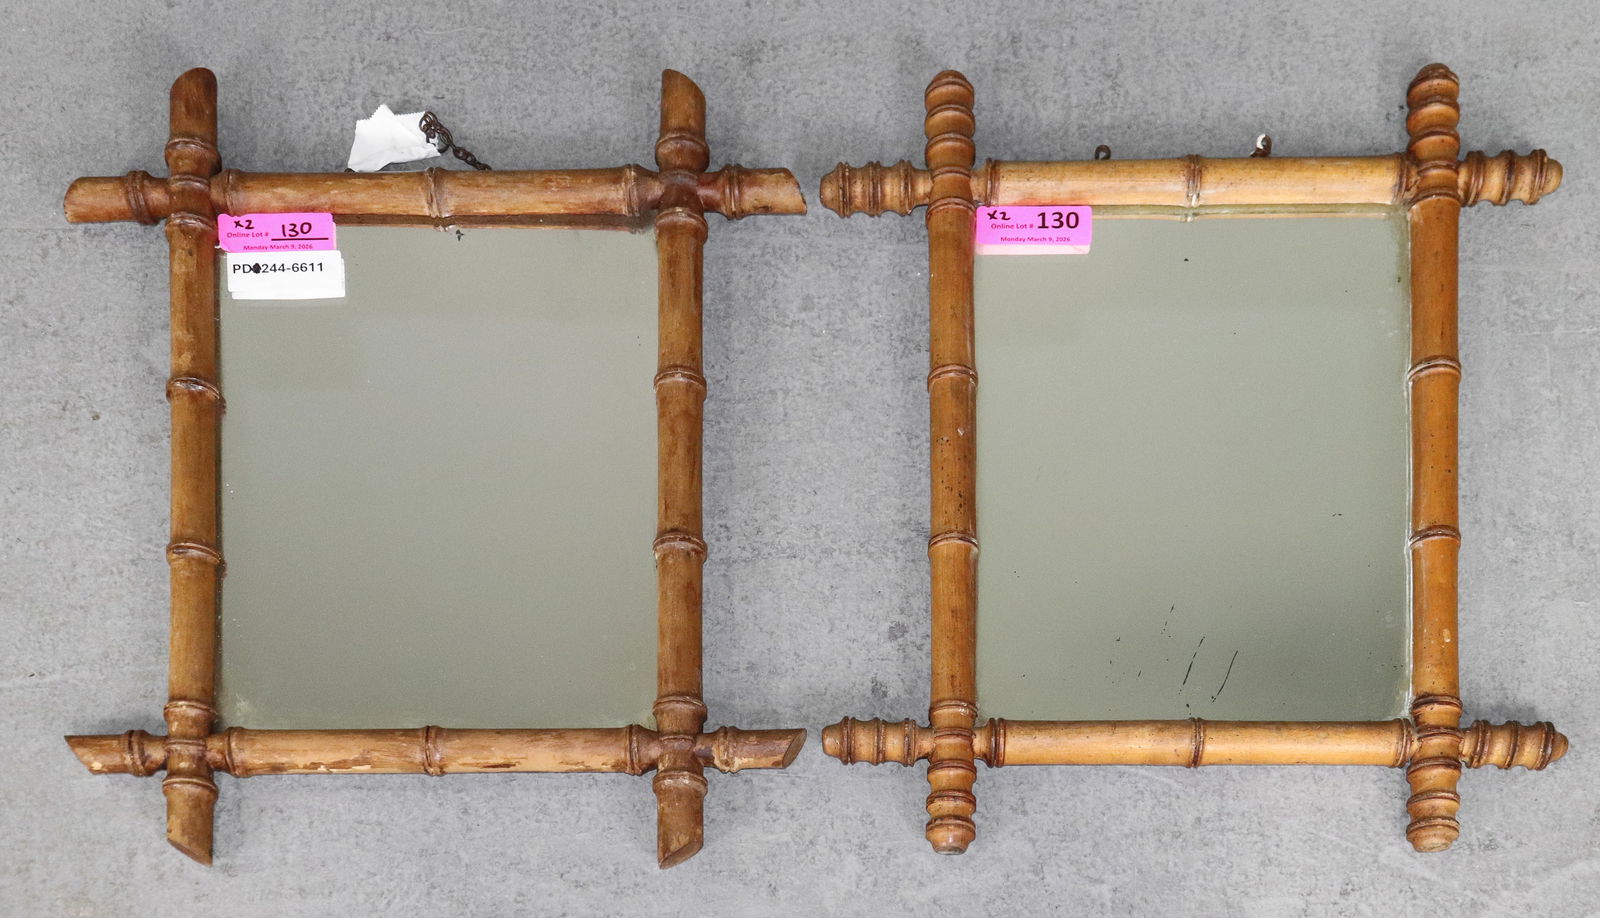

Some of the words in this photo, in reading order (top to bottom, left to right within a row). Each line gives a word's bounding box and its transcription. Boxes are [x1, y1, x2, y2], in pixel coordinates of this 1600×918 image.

[1037, 211, 1079, 229] 130
[282, 222, 312, 237] 130
[233, 262, 324, 274] PD244-6611
